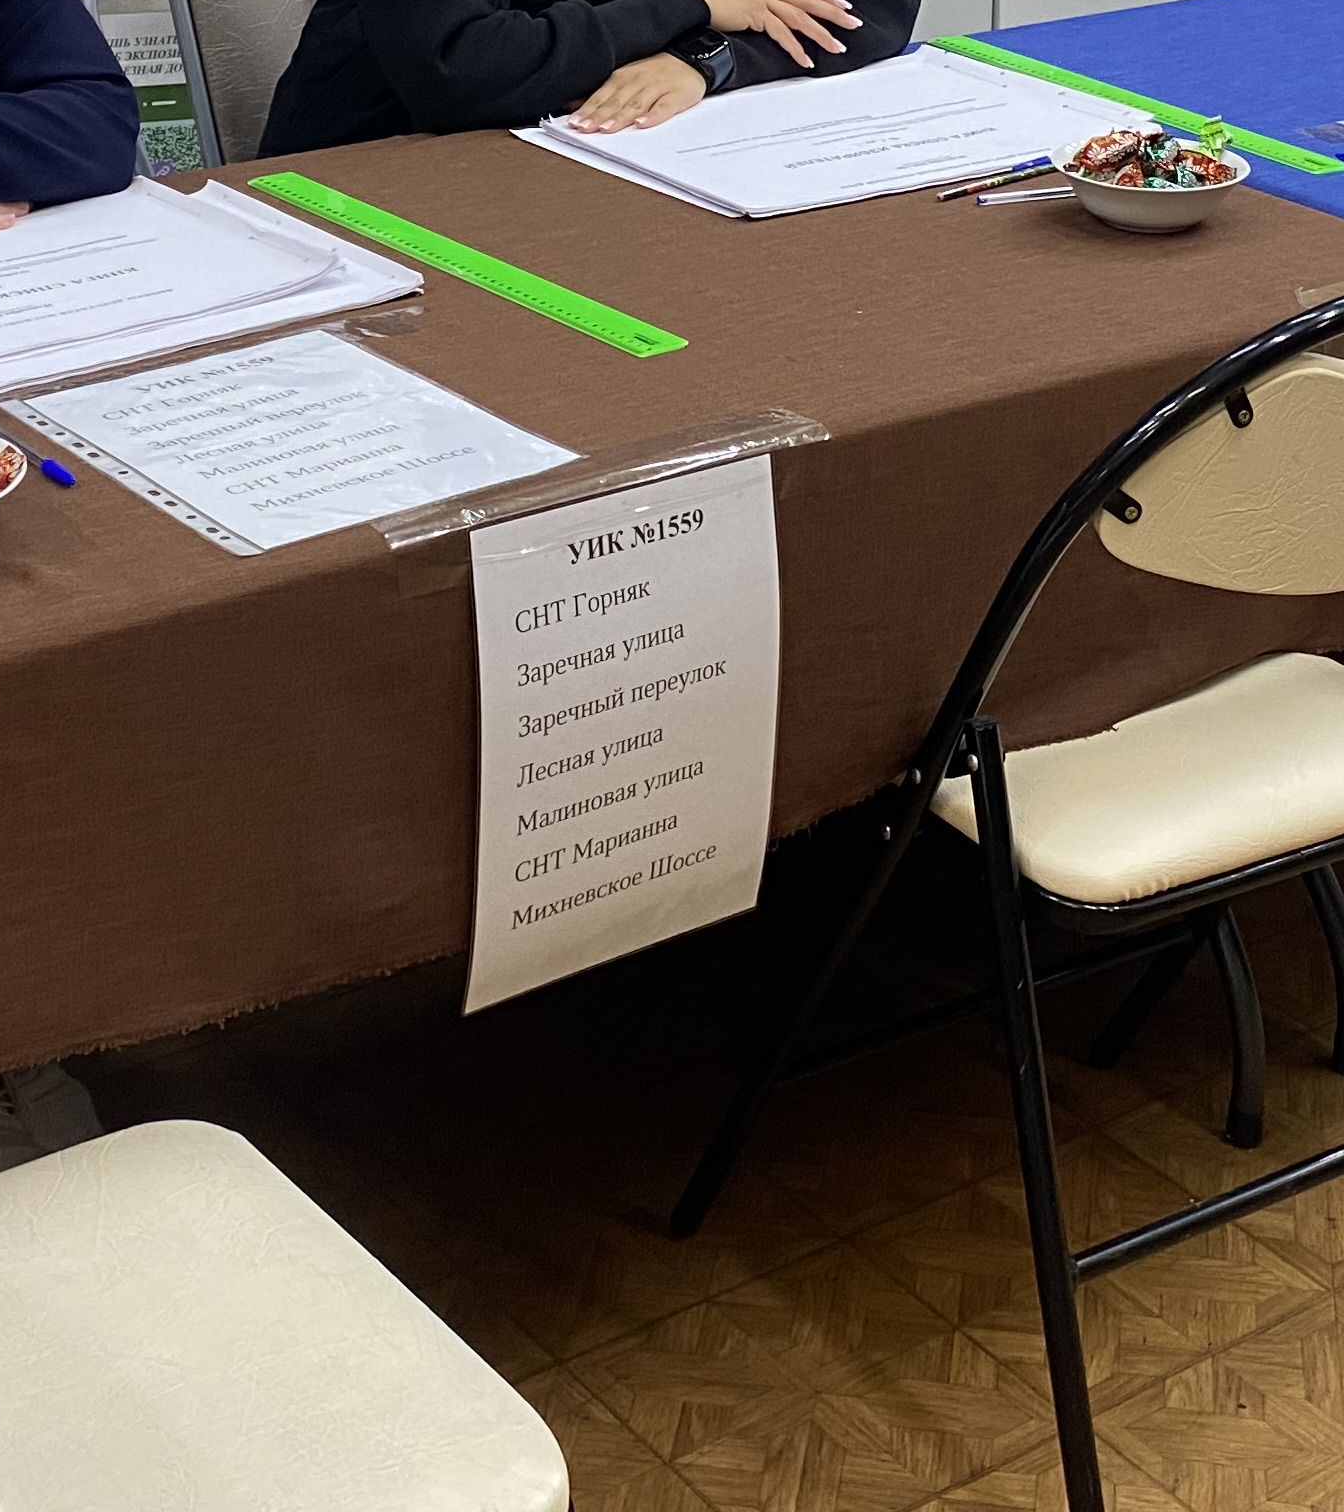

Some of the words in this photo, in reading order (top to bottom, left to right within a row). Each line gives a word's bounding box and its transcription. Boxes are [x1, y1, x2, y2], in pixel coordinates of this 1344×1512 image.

[70, 266, 139, 286] КНИГА
[101, 402, 156, 422] СНТ
[159, 382, 243, 409] Горняк
[137, 373, 200, 394] УИК
[202, 354, 275, 380] №1559
[124, 405, 228, 437] Заречная
[232, 387, 300, 413] улица
[146, 417, 262, 451] Заречный
[265, 389, 368, 422] переулок
[174, 437, 256, 466] Лесная
[259, 418, 331, 446] улица
[199, 439, 332, 480] Малиновая
[335, 421, 402, 447] улица
[224, 474, 282, 496] СНТ
[286, 443, 405, 480] Марианна
[249, 466, 397, 513] Михневское
[397, 443, 478, 471] Шоссе
[566, 530, 625, 565] УИК
[630, 508, 704, 549] №1559
[515, 599, 566, 633] СНТ
[572, 581, 651, 617] Горняк
[517, 642, 615, 687] Заречная
[622, 623, 686, 661] улица
[518, 687, 625, 738] Заречный
[630, 659, 727, 702] переулок
[516, 748, 595, 788] Лесная
[601, 726, 664, 766] улица
[516, 782, 637, 836] Малиновая
[643, 760, 704, 798] улица
[514, 848, 566, 883] СНТ
[572, 814, 678, 864] Марианна
[511, 870, 643, 931] Михневское
[648, 845, 717, 881] Шоссе
